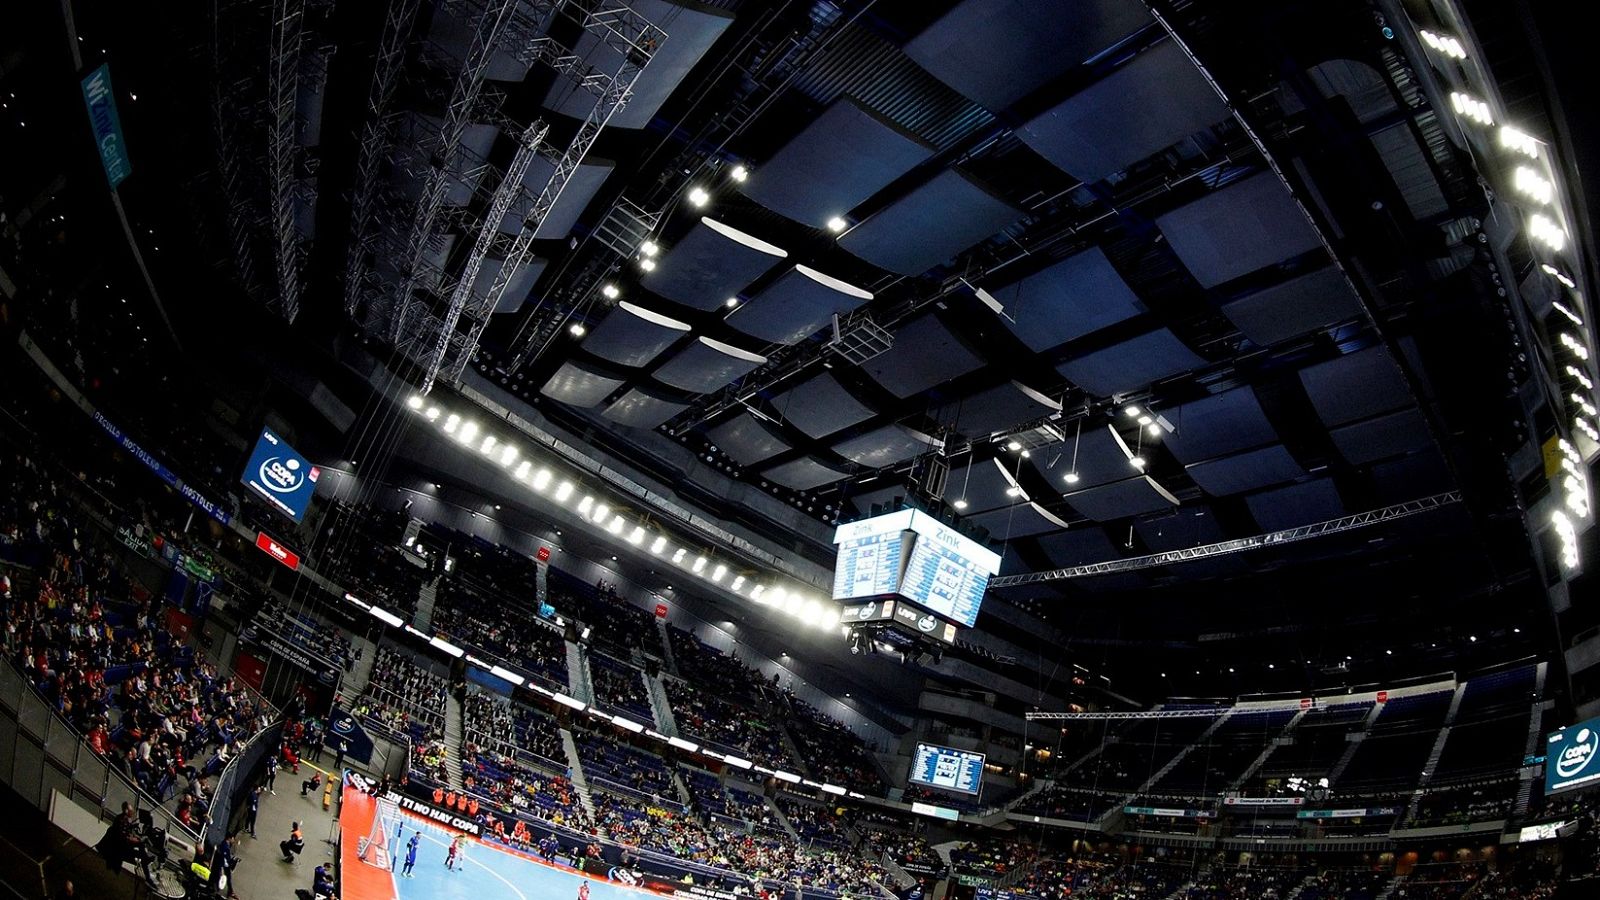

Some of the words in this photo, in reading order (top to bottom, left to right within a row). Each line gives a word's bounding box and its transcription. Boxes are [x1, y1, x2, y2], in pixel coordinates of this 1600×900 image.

[95, 411, 121, 438] ORGULLO
[271, 461, 296, 485] COPA
[1565, 743, 1591, 760] COPA
[402, 797, 414, 809] TI
[414, 801, 430, 816] NO
[429, 808, 452, 825] HAY
[451, 818, 480, 835] COPA
[961, 874, 989, 885] SALIDA
